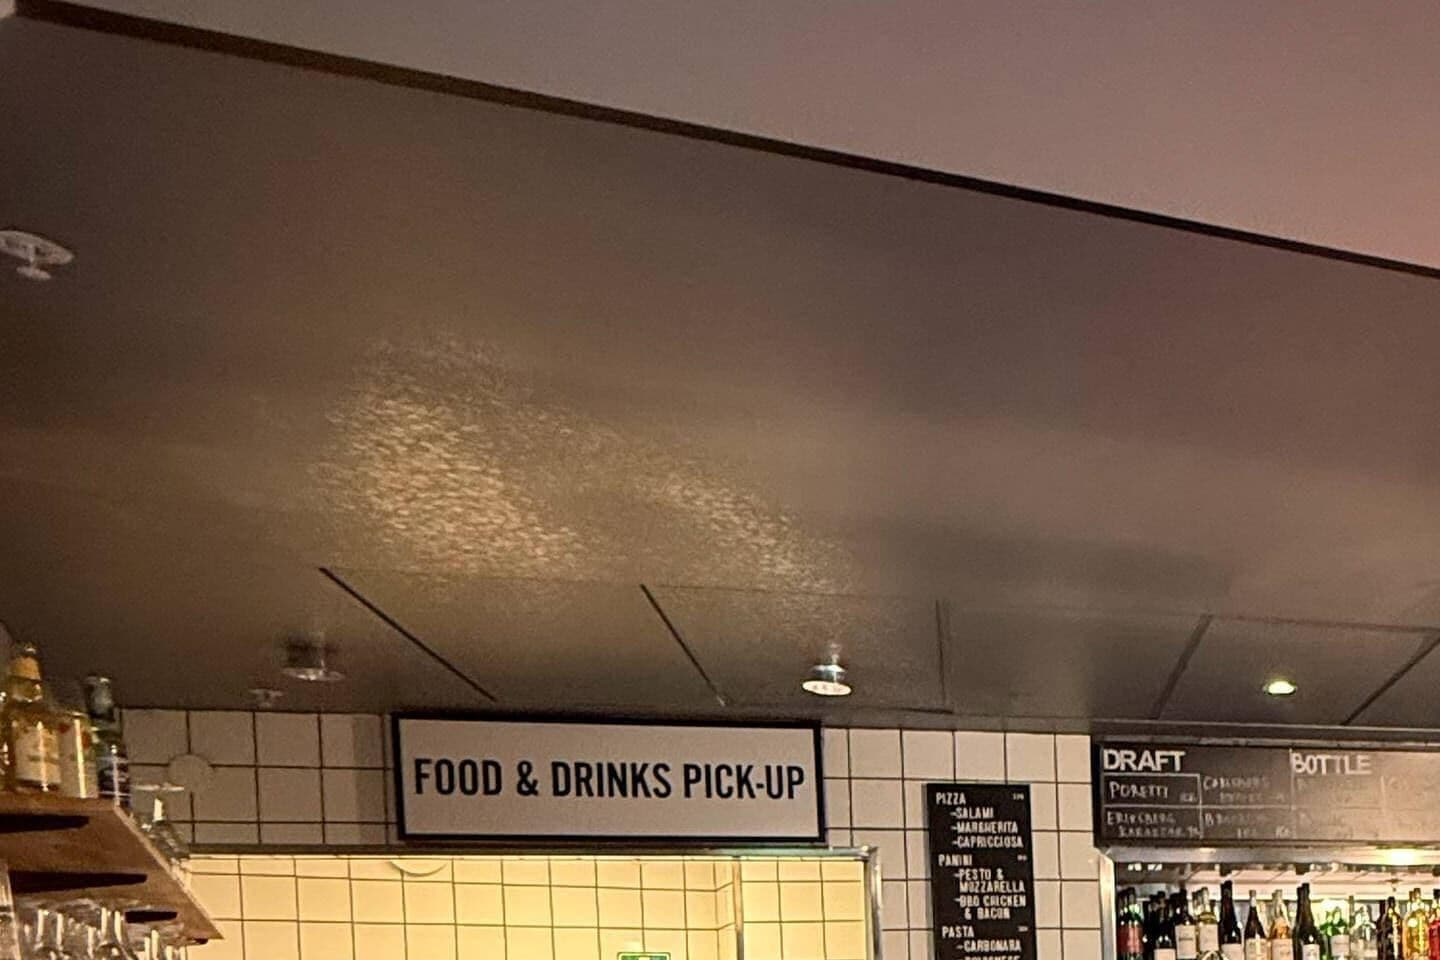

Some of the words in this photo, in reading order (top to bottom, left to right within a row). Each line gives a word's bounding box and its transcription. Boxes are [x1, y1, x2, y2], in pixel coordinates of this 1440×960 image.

[1103, 749, 1186, 772] DRAFT
[1292, 752, 1372, 775] BOTTLE
[414, 758, 502, 796] FOOD
[516, 760, 538, 797] &
[551, 761, 672, 799] DRINKS
[683, 764, 805, 800] PICK-UP
[935, 792, 966, 805] PIZZA
[938, 854, 973, 866] PANINI
[996, 868, 1004, 880] &
[959, 881, 1026, 893] MOZZARELLA
[982, 895, 1027, 907] CHICKEN
[976, 907, 1011, 919] BACON
[942, 926, 975, 938] PASTA
